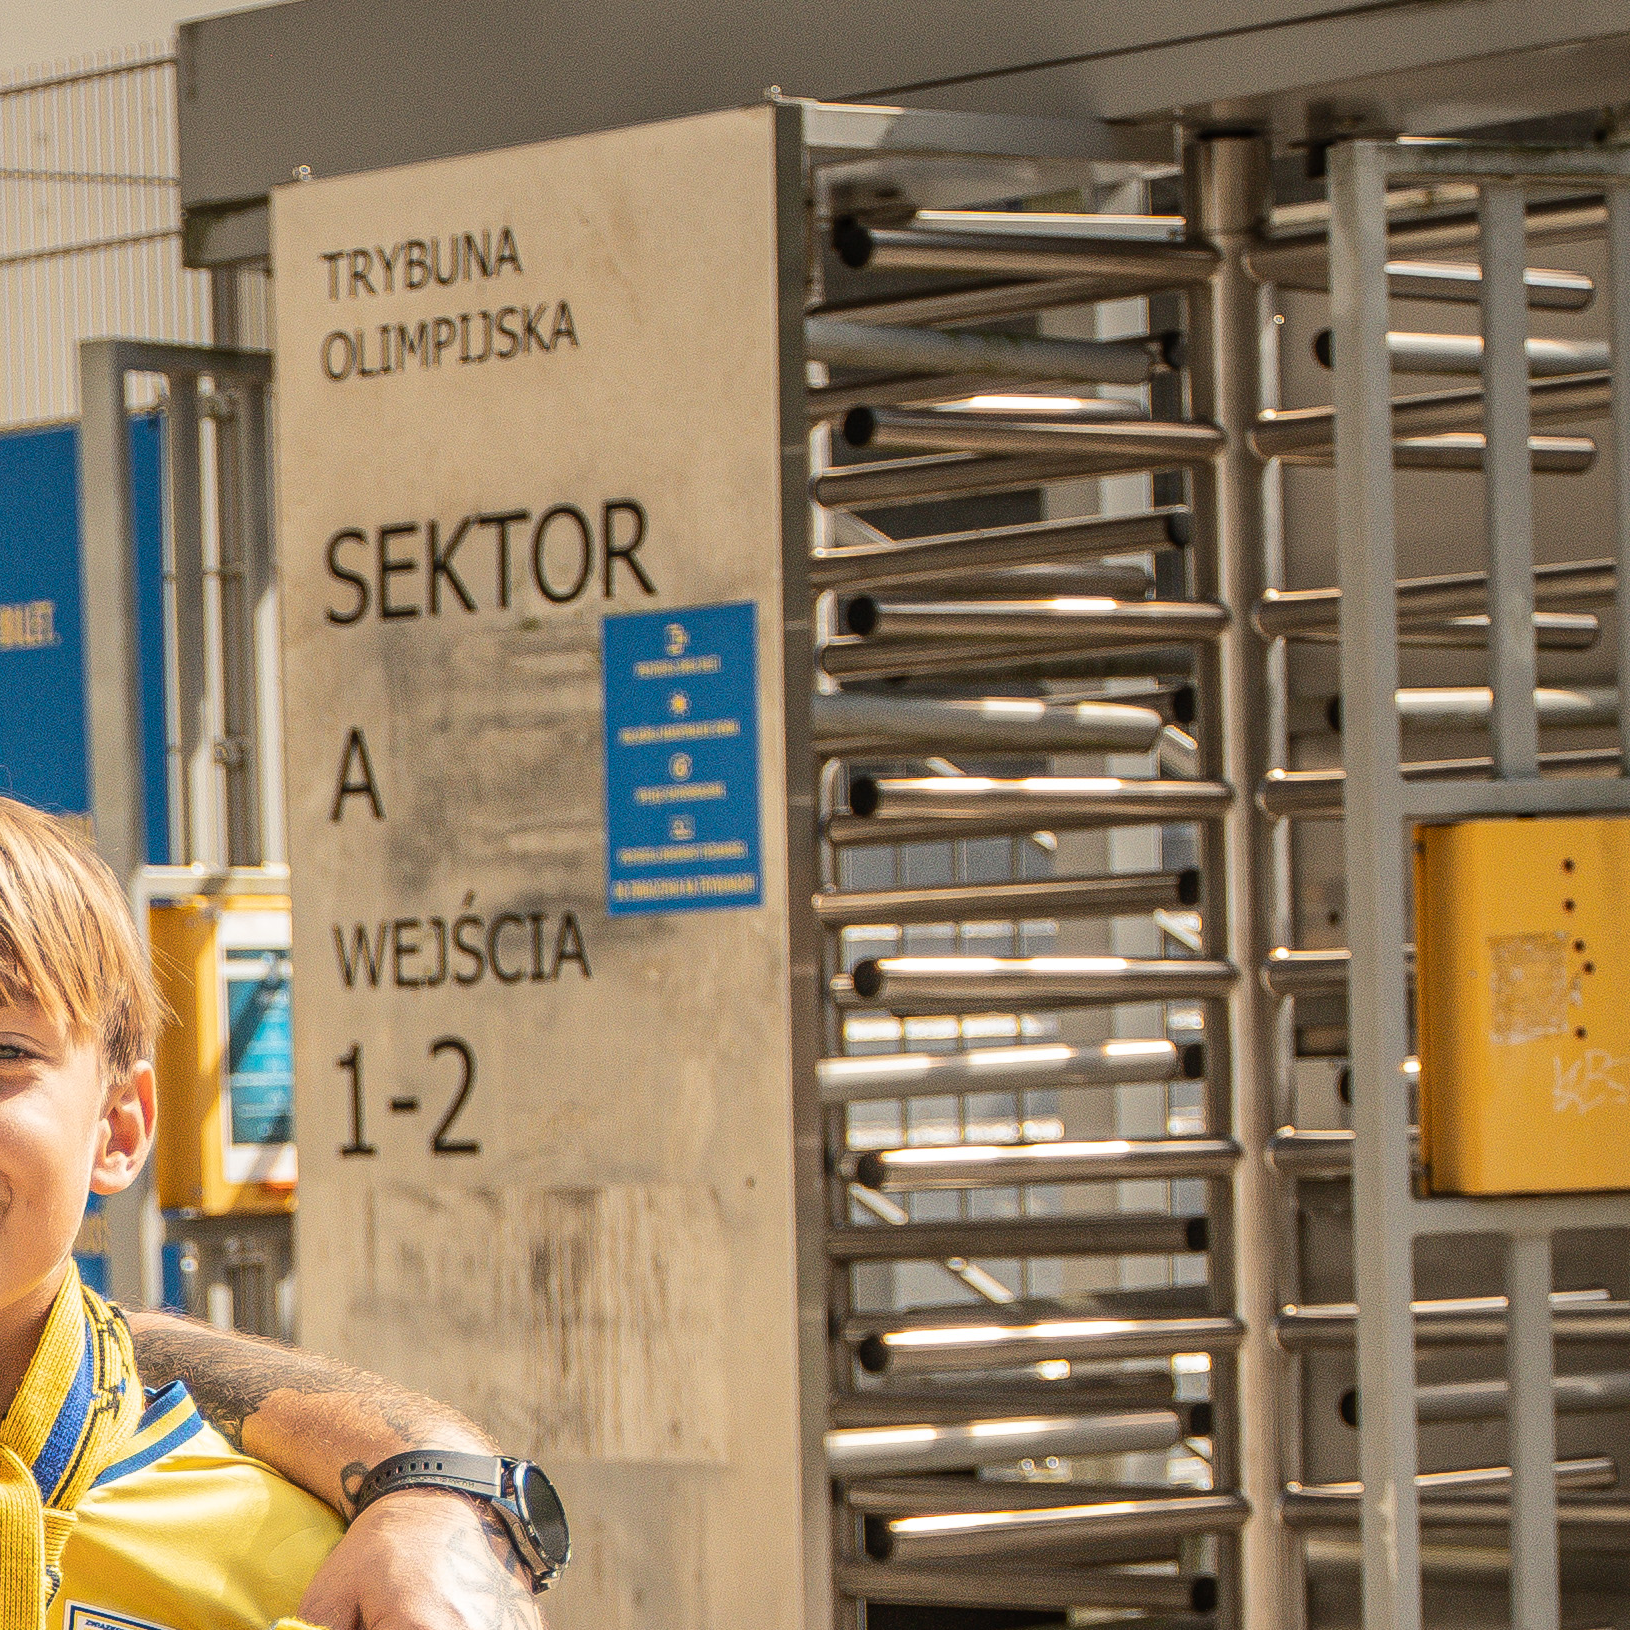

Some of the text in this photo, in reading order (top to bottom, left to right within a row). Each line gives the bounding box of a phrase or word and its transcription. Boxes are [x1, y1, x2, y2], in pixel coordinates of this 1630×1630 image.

[320, 227, 523, 300] TRYBUNA
[321, 301, 579, 381] OLIMPIJSKA
[325, 498, 657, 627] SEKTOR
[329, 727, 386, 822] A
[333, 890, 593, 989] WEJŚCIA
[334, 1036, 481, 1158] 1-2
